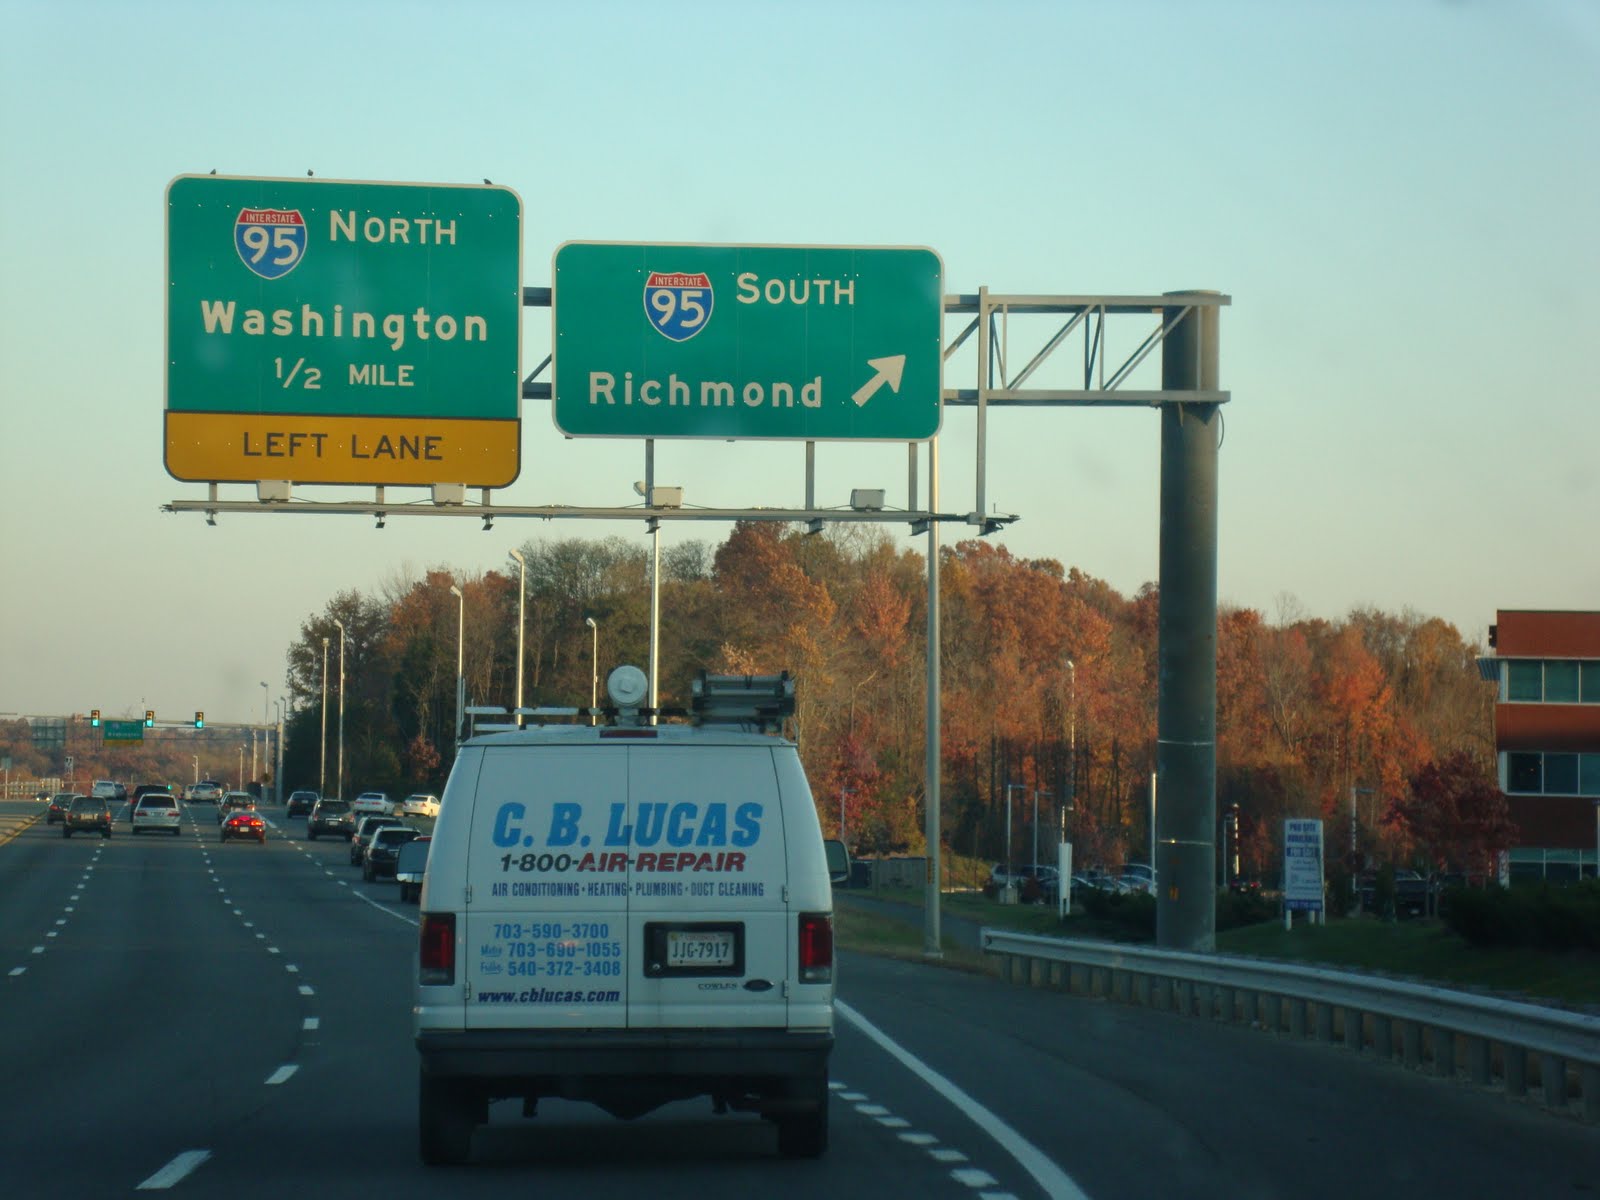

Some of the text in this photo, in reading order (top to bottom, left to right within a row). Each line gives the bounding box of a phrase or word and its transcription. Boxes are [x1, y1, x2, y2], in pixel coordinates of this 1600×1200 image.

[246, 213, 295, 224] INTERSTATE
[330, 210, 456, 245] NORTH
[243, 227, 299, 265] 95
[655, 276, 703, 287] INTERSTATE
[736, 273, 855, 305] SOUTH
[651, 290, 705, 328] 95
[201, 301, 487, 351] Washington
[275, 357, 414, 389] 1/2 MILE
[589, 371, 822, 408] Richmond
[243, 432, 443, 461] LEFT LANE
[492, 802, 764, 848] C. B. LUCAS
[500, 852, 746, 872] 1-800-AIR-REPAIR
[492, 882, 764, 897] AIR CONDITIONING HEATING PLUMBING DUCT CLEANING
[494, 923, 609, 939] 703-590-3700
[507, 942, 621, 958] 703-690-1055
[507, 961, 621, 976] 540-372-3408
[478, 987, 620, 1003] www.cblucas.com
